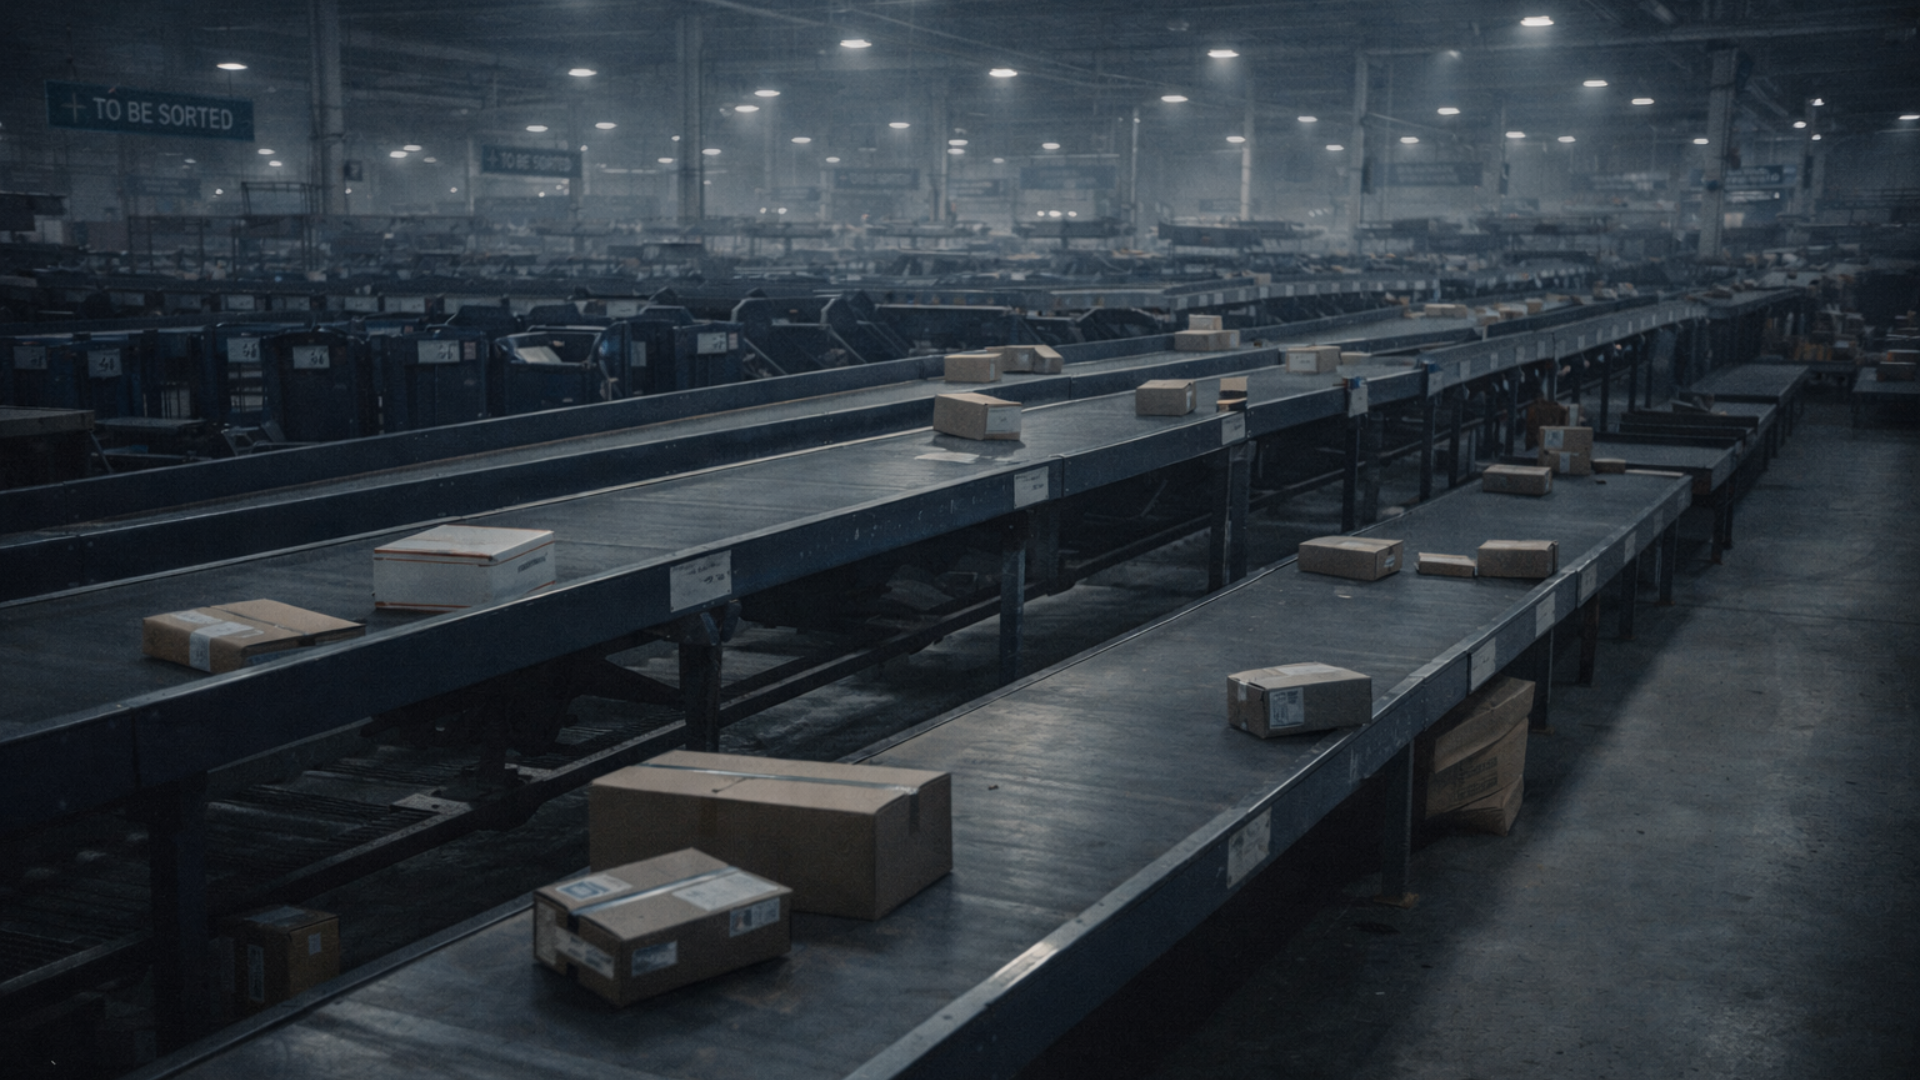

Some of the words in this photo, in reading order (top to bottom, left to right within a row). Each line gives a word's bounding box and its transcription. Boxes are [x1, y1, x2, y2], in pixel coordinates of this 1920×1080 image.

[93, 97, 121, 121] TO
[128, 101, 154, 124] BE
[158, 103, 233, 130] SORTED
